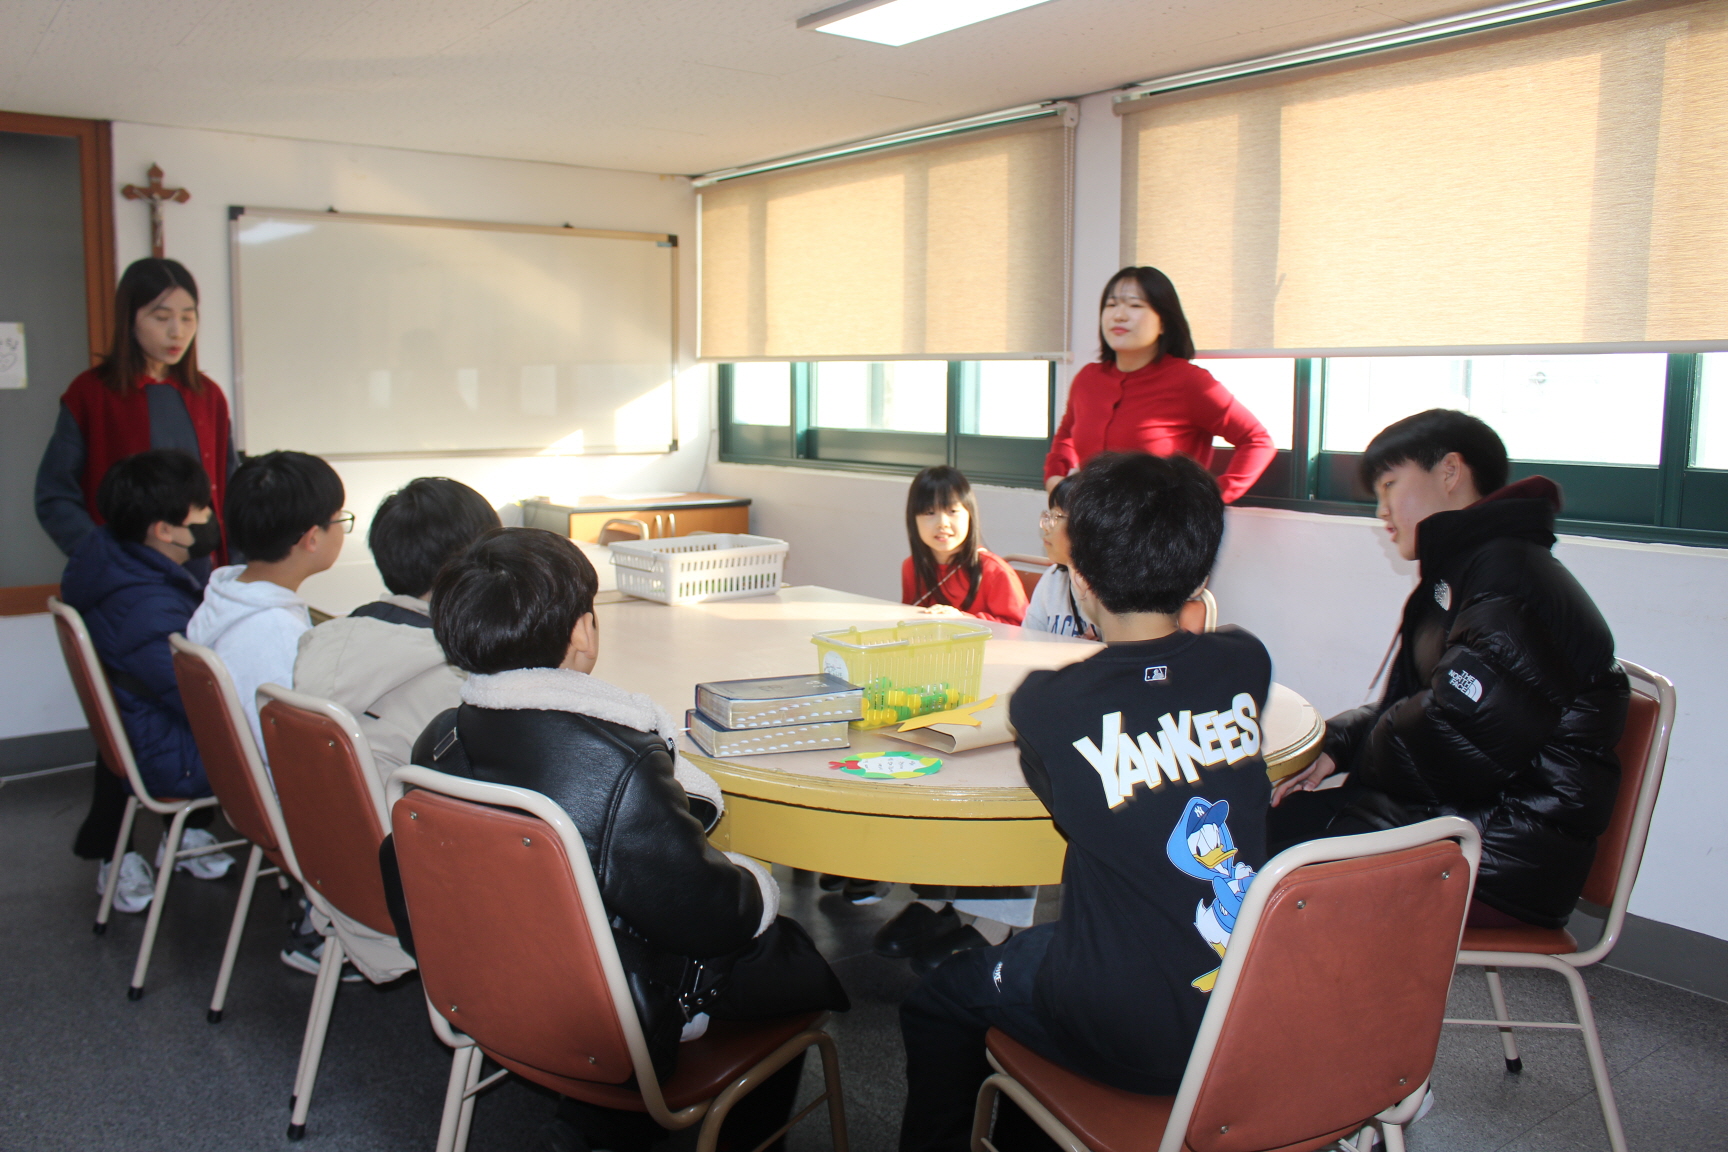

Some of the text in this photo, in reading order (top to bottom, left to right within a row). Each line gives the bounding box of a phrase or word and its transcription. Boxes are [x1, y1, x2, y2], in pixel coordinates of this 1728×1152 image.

[1448, 669, 1471, 688] NORTH
[1461, 670, 1475, 682] THE
[1449, 679, 1466, 693] FACE
[1072, 692, 1261, 810] YANKEES
